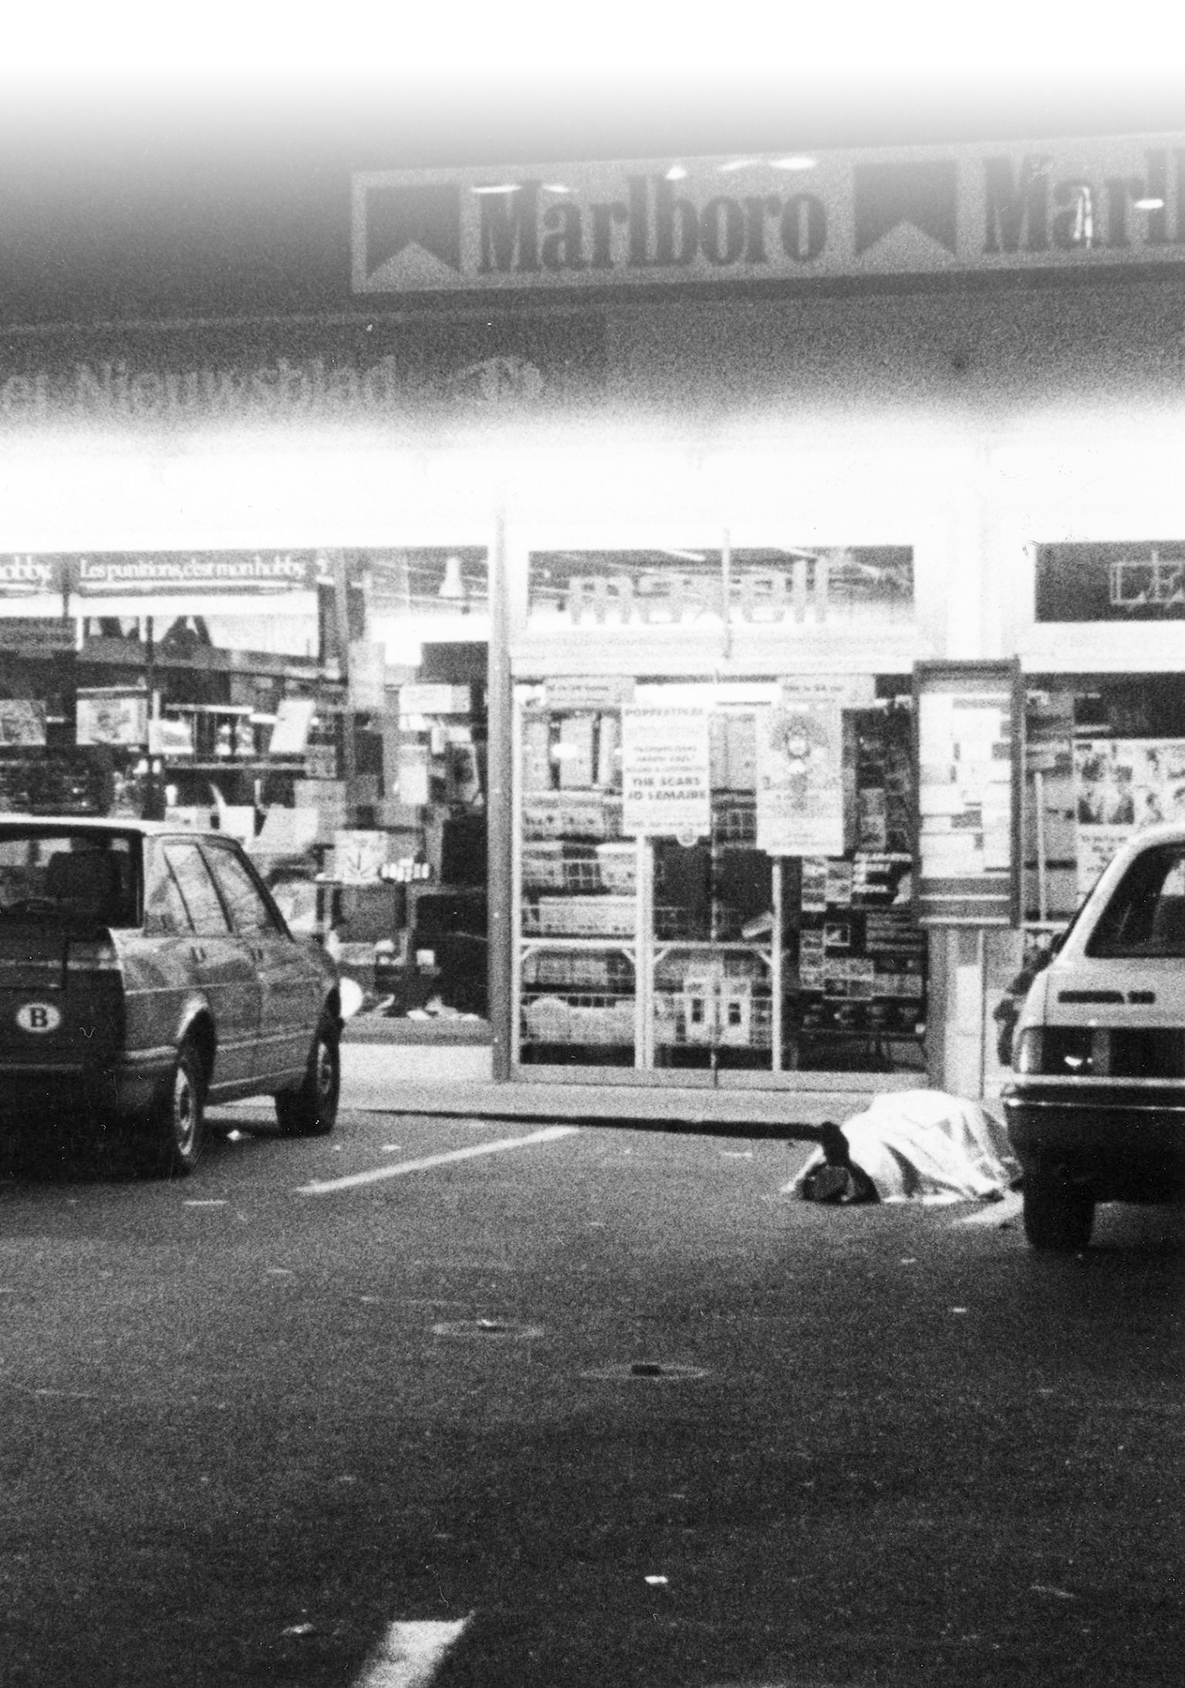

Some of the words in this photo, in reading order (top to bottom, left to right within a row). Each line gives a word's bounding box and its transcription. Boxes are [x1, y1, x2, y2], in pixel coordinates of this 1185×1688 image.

[474, 173, 828, 274] Marlboro
[73, 353, 398, 416] Nieuwsblad
[80, 558, 106, 578] Les
[217, 561, 254, 577] mon
[30, 1007, 49, 1028] B
